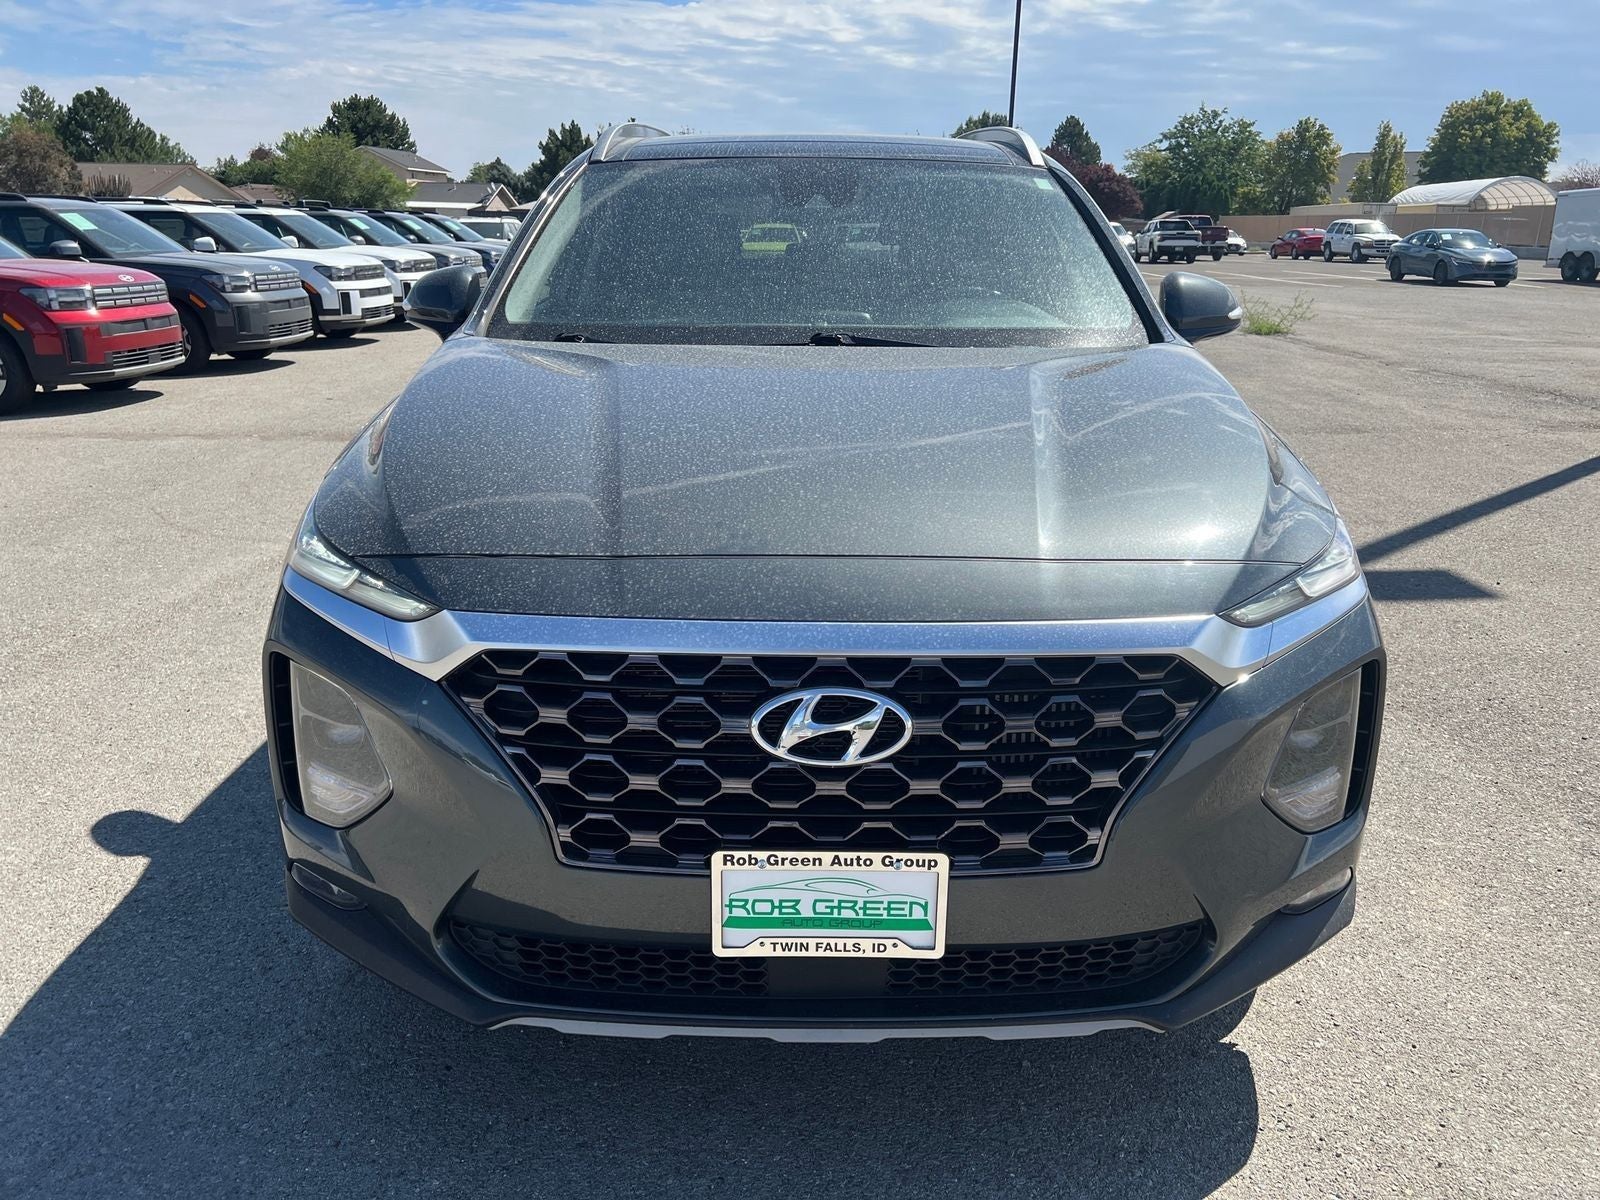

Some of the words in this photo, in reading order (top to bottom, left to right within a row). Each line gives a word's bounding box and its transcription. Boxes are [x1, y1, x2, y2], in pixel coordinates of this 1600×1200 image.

[722, 854, 759, 867] Rob
[766, 855, 823, 867] Green
[830, 855, 874, 868] Auto
[724, 898, 802, 916] ROB
[812, 898, 929, 918] GREEN
[781, 918, 824, 928] AUTO
[828, 918, 884, 929] GROUP
[770, 942, 812, 953] TWIN
[815, 942, 866, 955] FALLS,
[871, 943, 887, 954] ID
